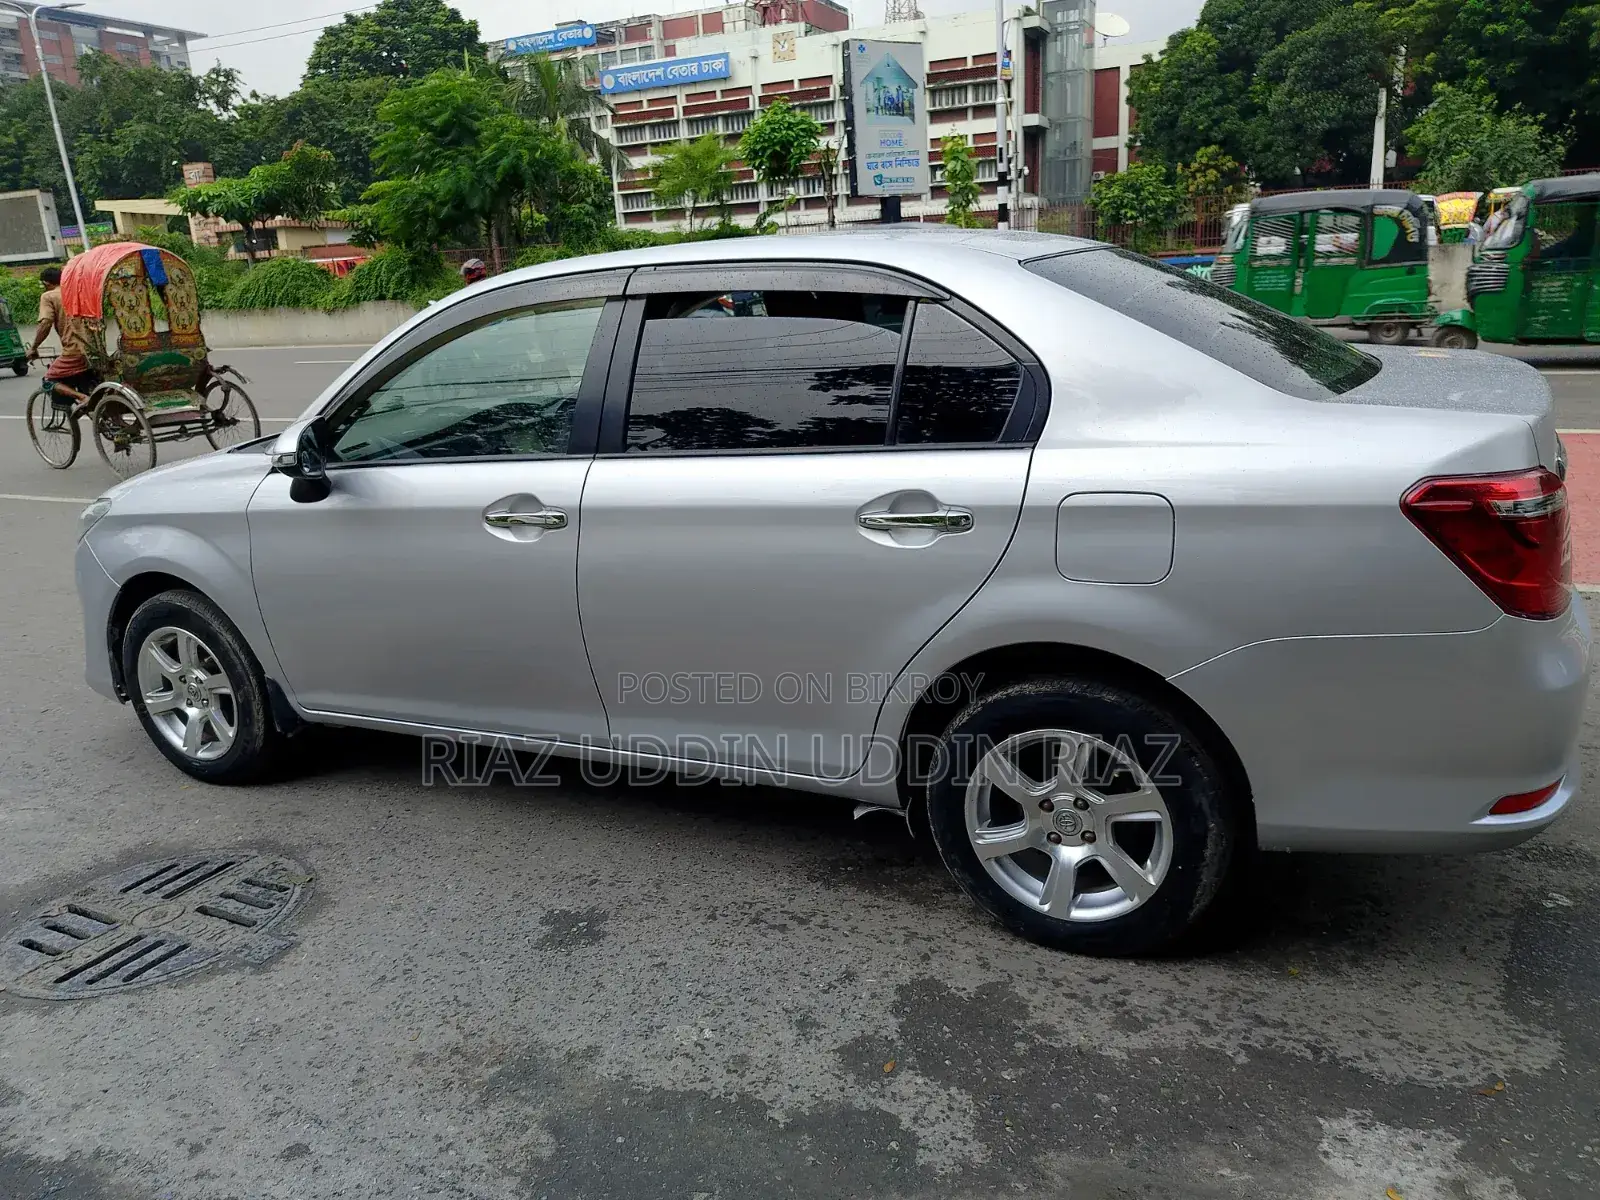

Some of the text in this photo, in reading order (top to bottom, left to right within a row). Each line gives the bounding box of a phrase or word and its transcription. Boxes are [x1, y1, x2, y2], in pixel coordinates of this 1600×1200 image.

[516, 32, 555, 49] বাংলাদেশ
[557, 28, 583, 42] বেতার
[616, 57, 727, 87] বাংলাদেশ বেতার ঢাকা
[879, 139, 904, 147] HOME
[866, 161, 879, 171] ঘরে
